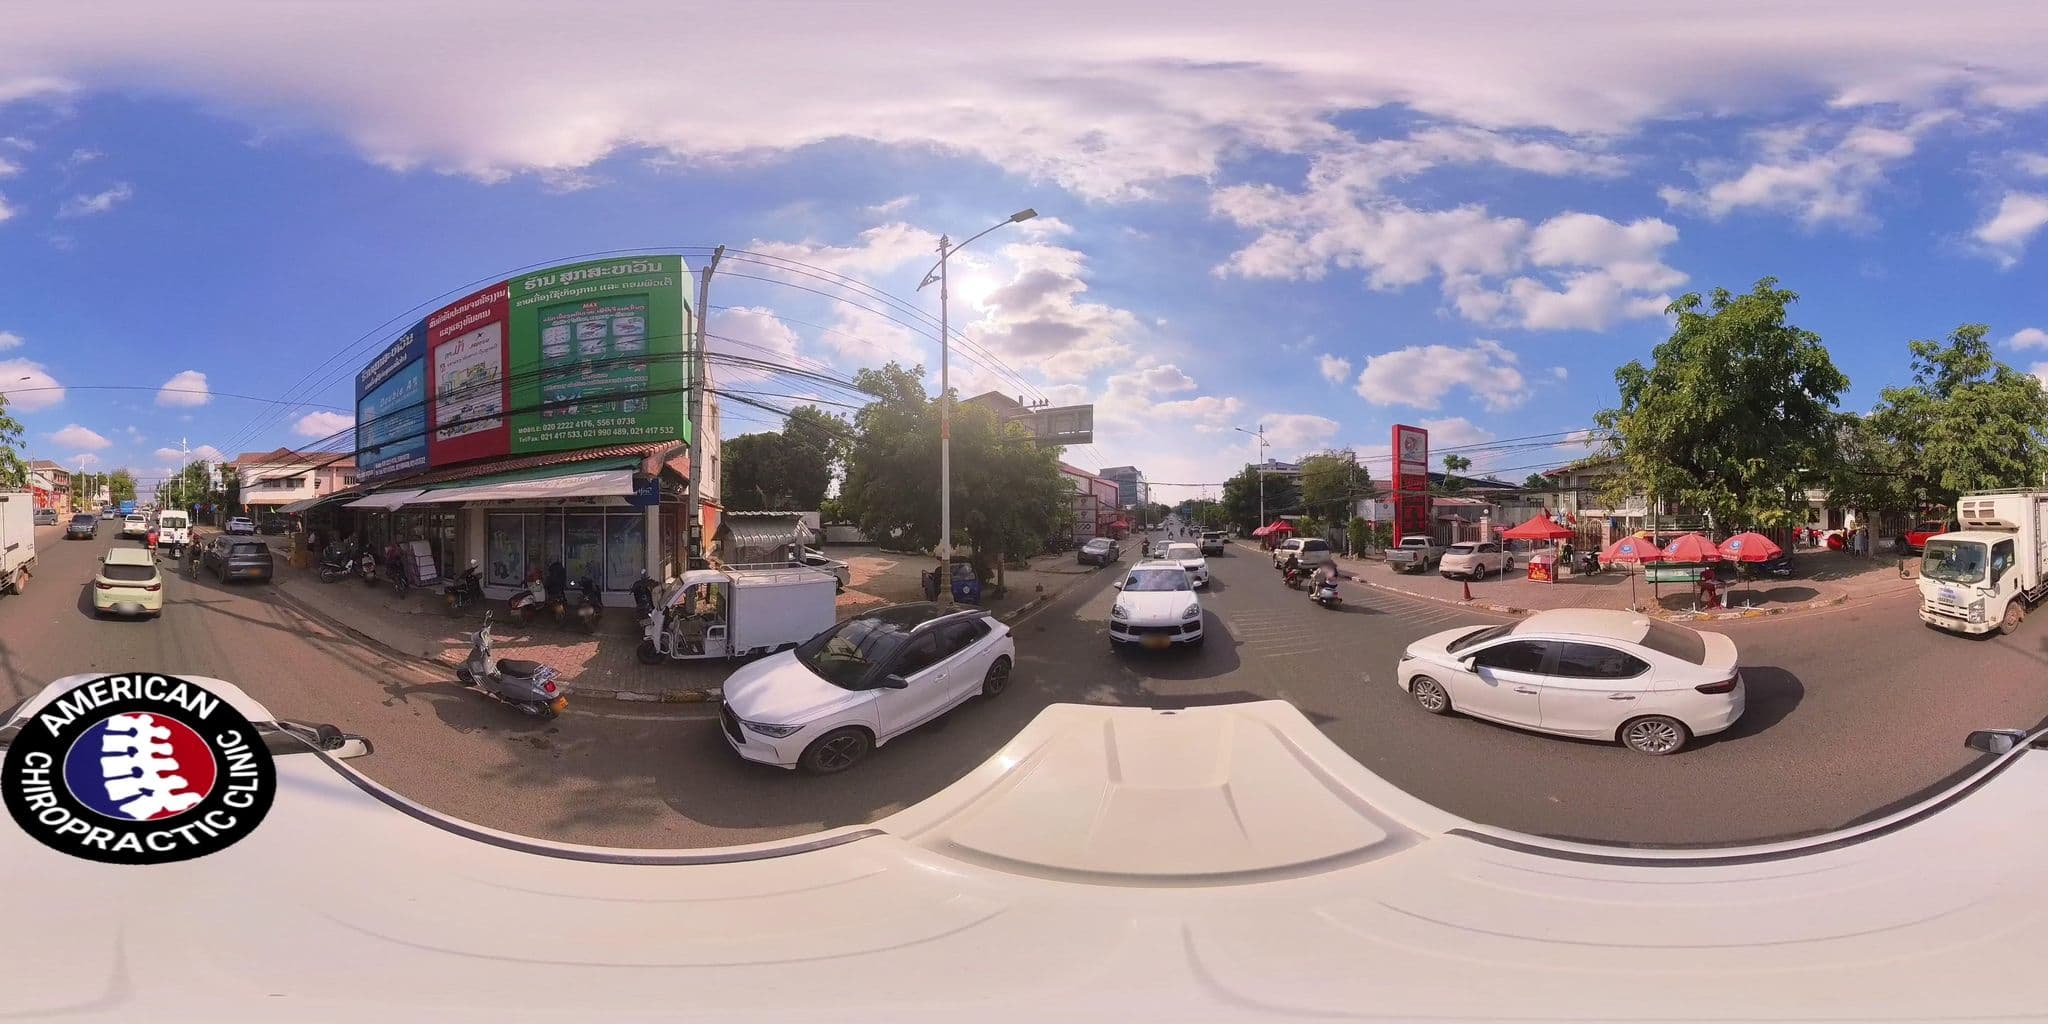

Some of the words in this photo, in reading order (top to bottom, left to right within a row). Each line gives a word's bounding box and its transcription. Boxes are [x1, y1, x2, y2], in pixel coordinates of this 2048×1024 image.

[542, 423, 556, 431] 020
[556, 421, 574, 430] 2222
[575, 420, 595, 428] 4176,
[617, 417, 636, 425] 0738
[554, 431, 566, 439] 417
[567, 430, 583, 438] 533,
[583, 429, 596, 437] 021
[597, 428, 612, 436] 990
[612, 427, 629, 436] 489,
[630, 427, 643, 435] 021
[645, 426, 658, 434] 417
[660, 426, 674, 434] 532
